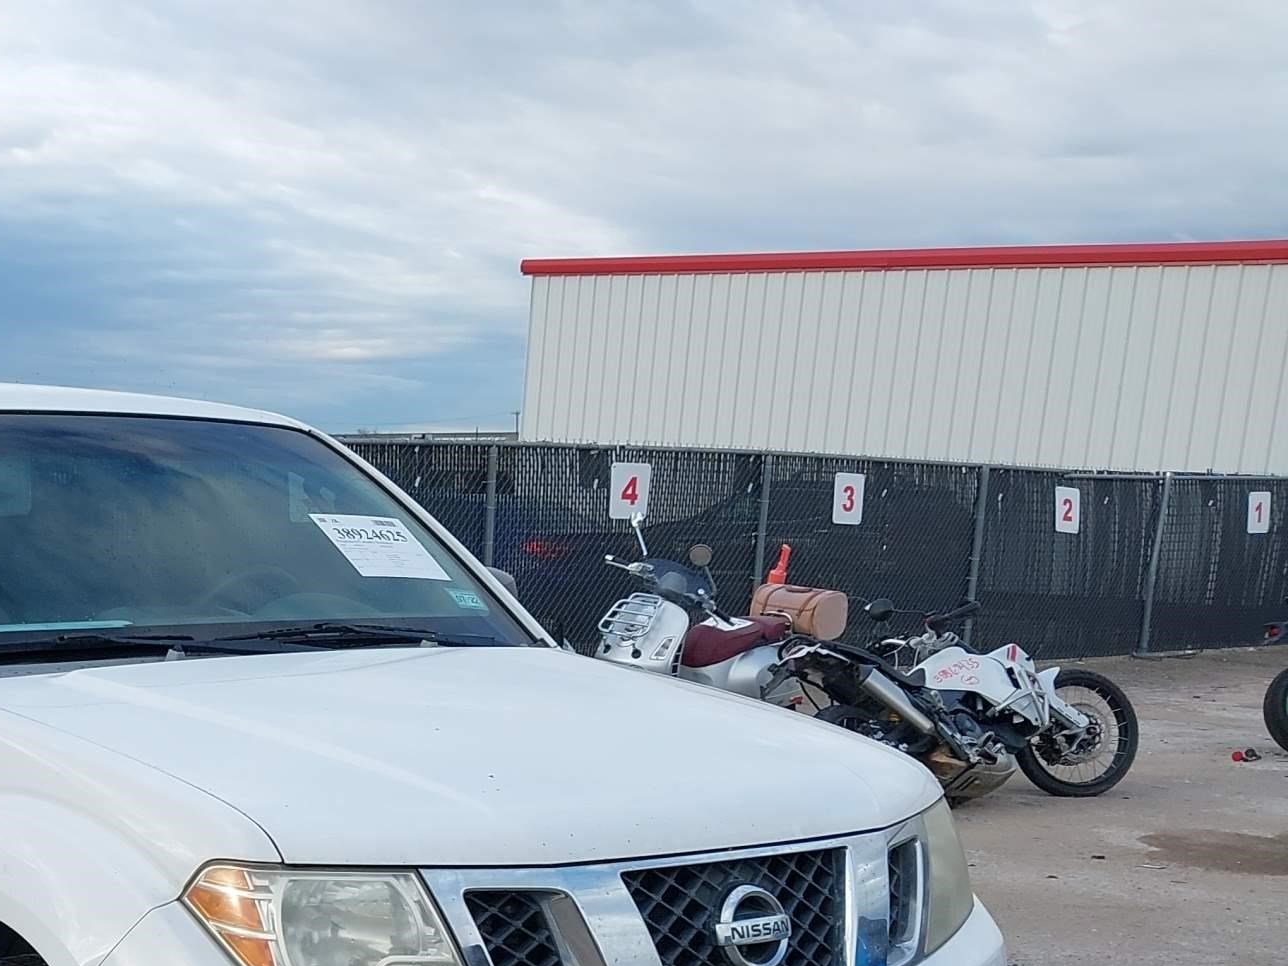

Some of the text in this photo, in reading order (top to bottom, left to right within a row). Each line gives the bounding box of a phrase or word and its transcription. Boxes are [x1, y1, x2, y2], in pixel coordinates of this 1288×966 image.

[621, 476, 639, 506] 4
[842, 485, 855, 512] 3
[1062, 498, 1073, 522] 2
[1255, 501, 1263, 523] 1
[332, 527, 408, 543] 38924625
[731, 919, 789, 940] NISSAN
